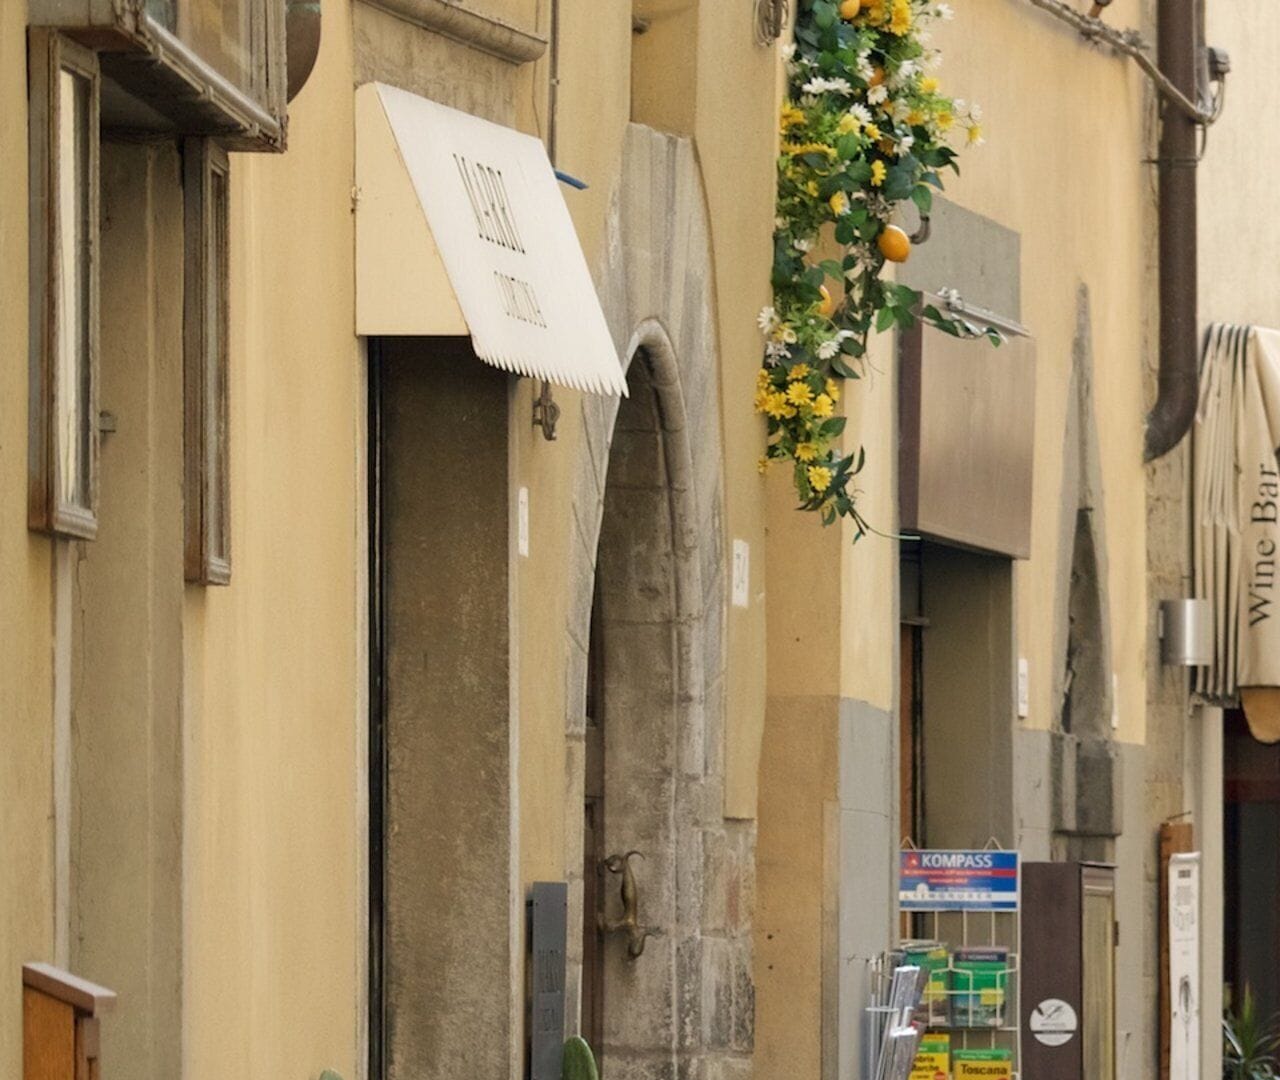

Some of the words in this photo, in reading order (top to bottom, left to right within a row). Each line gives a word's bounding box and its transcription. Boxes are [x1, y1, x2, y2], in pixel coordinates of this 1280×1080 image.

[1249, 538, 1278, 627] Wine
[921, 853, 993, 868] KOMPASS
[960, 1063, 1008, 1076] Toscana
